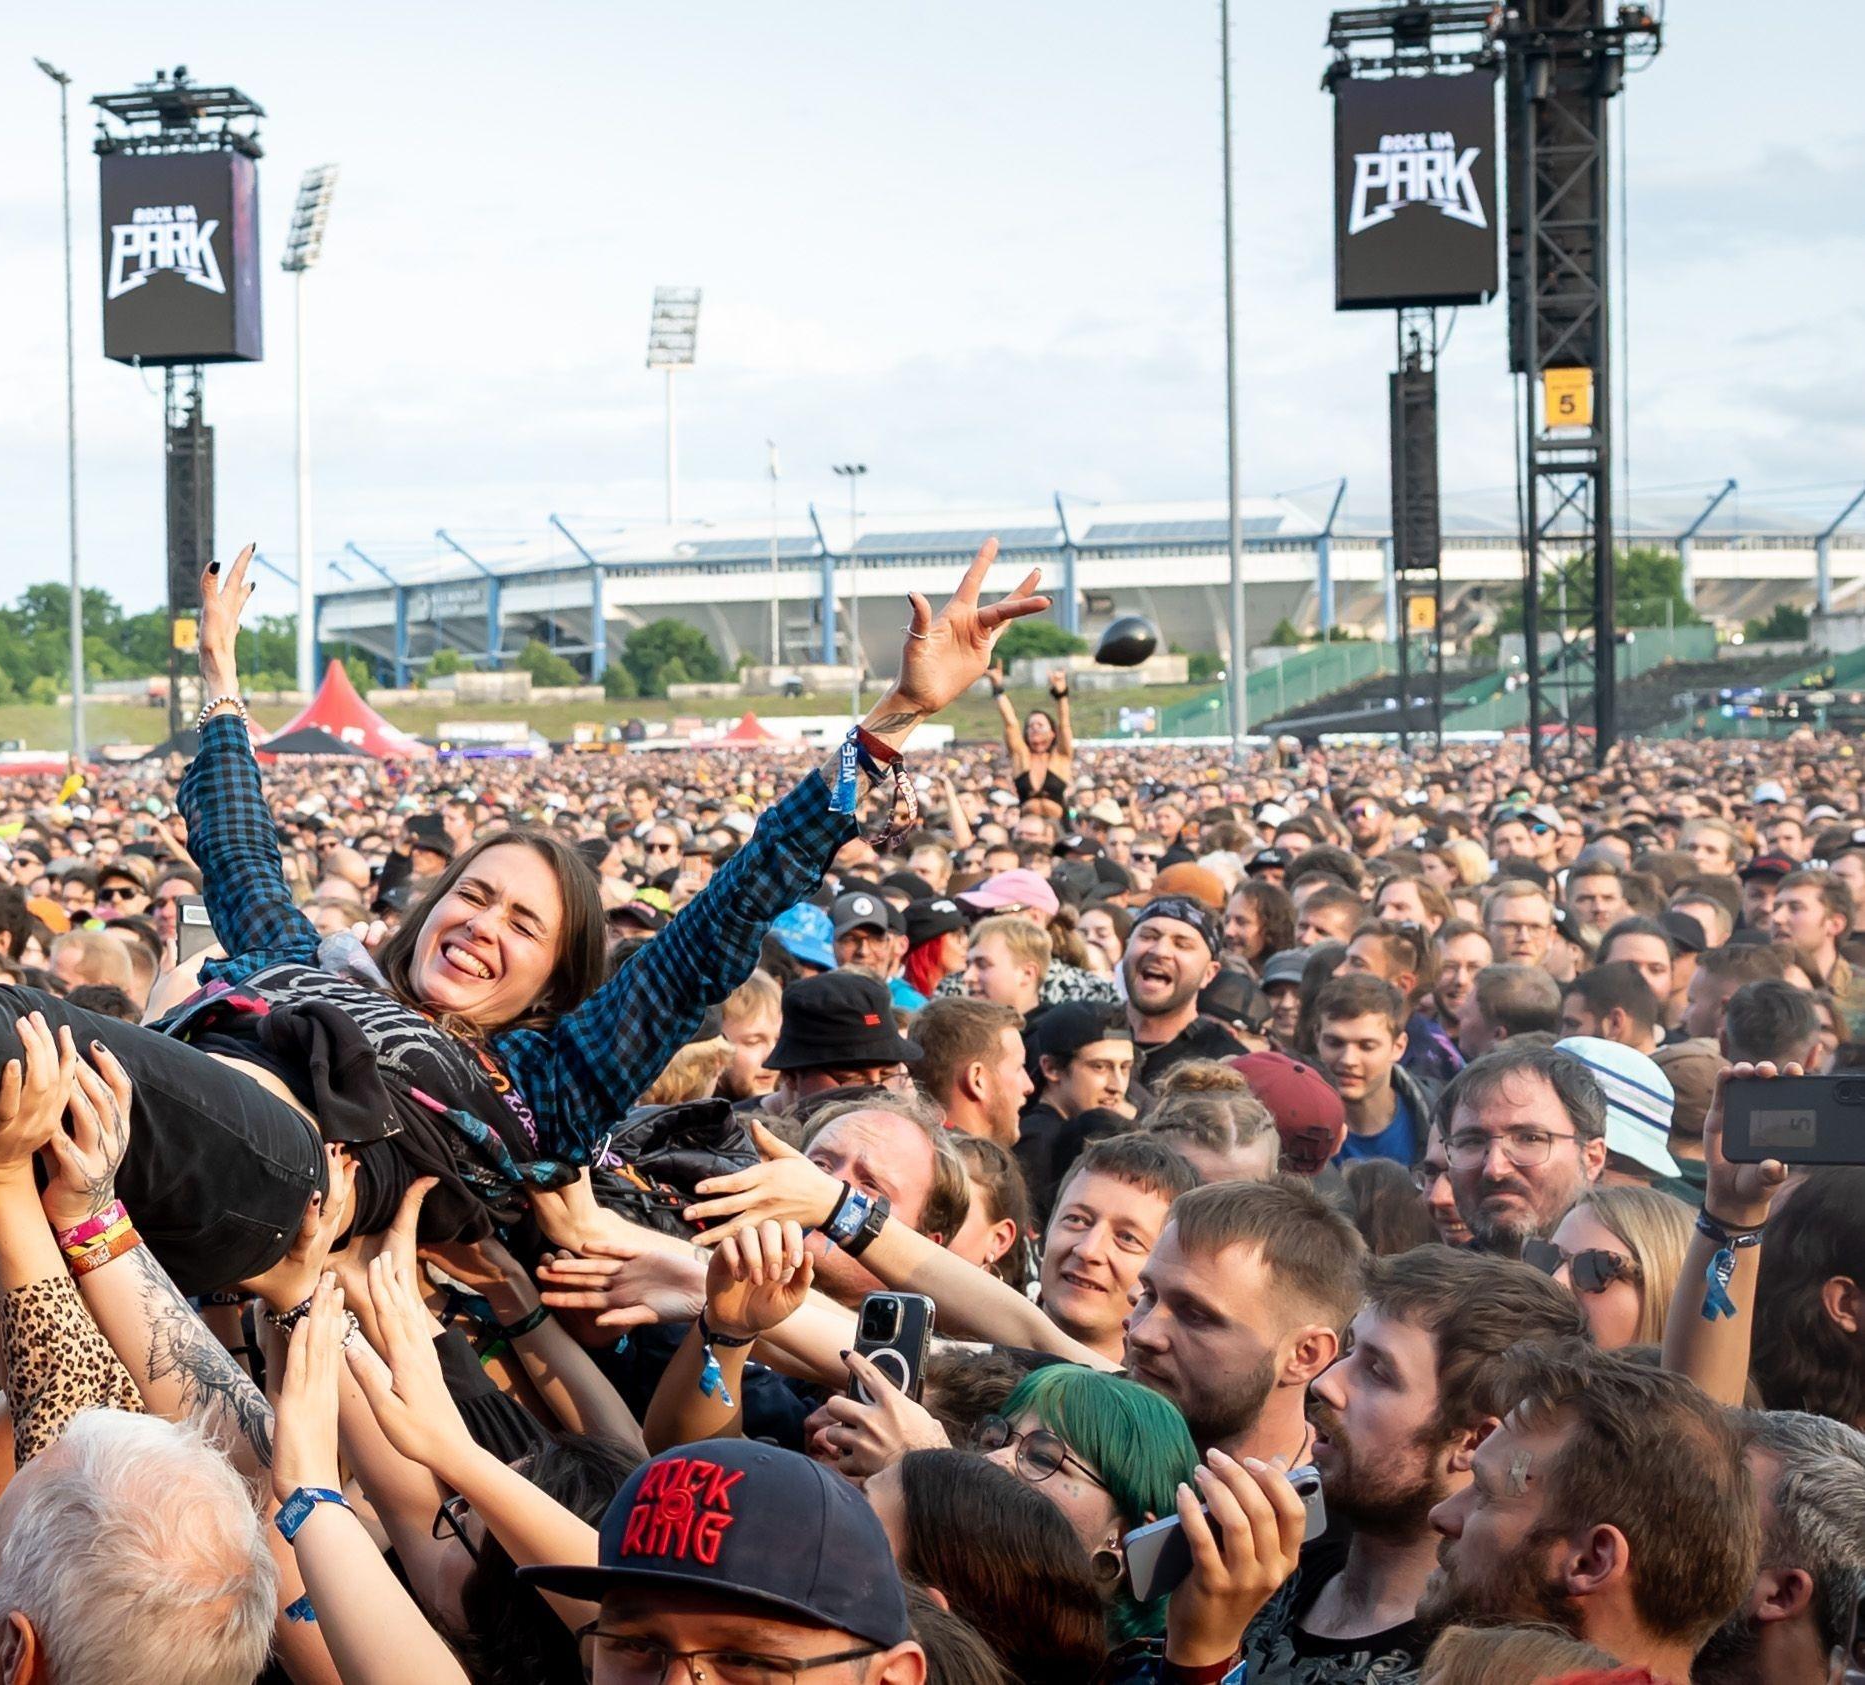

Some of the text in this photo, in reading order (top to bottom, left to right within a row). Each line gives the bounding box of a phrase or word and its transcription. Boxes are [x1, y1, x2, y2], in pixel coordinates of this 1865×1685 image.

[1348, 147, 1488, 235] PARK
[108, 219, 226, 299] PARK
[1559, 394, 1575, 415] 5
[636, 1458, 746, 1511] ROCK
[620, 1504, 734, 1566] RING
